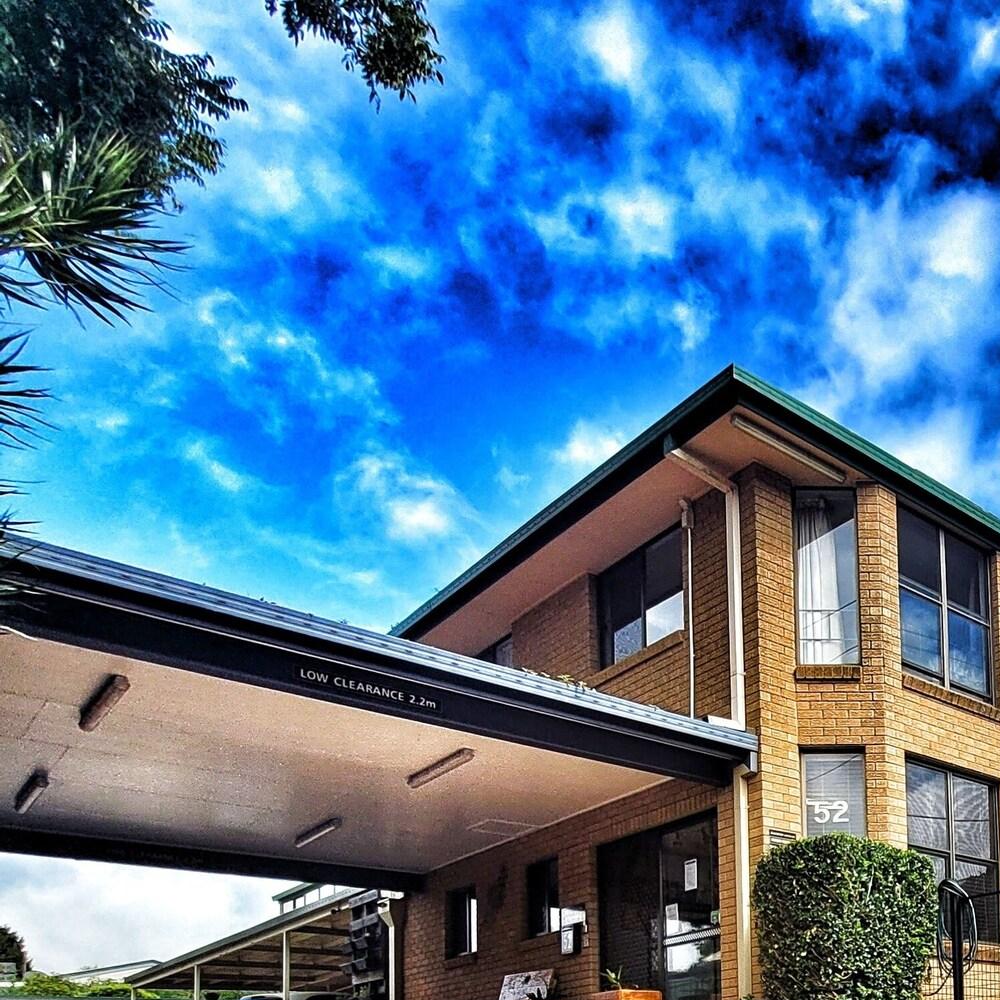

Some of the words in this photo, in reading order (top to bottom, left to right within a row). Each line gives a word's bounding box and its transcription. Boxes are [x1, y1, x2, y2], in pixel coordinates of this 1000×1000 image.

[300, 668, 329, 683] LOW
[333, 677, 405, 701] CLEARANCE
[409, 694, 436, 709] 2.2m
[813, 800, 849, 823] 52
